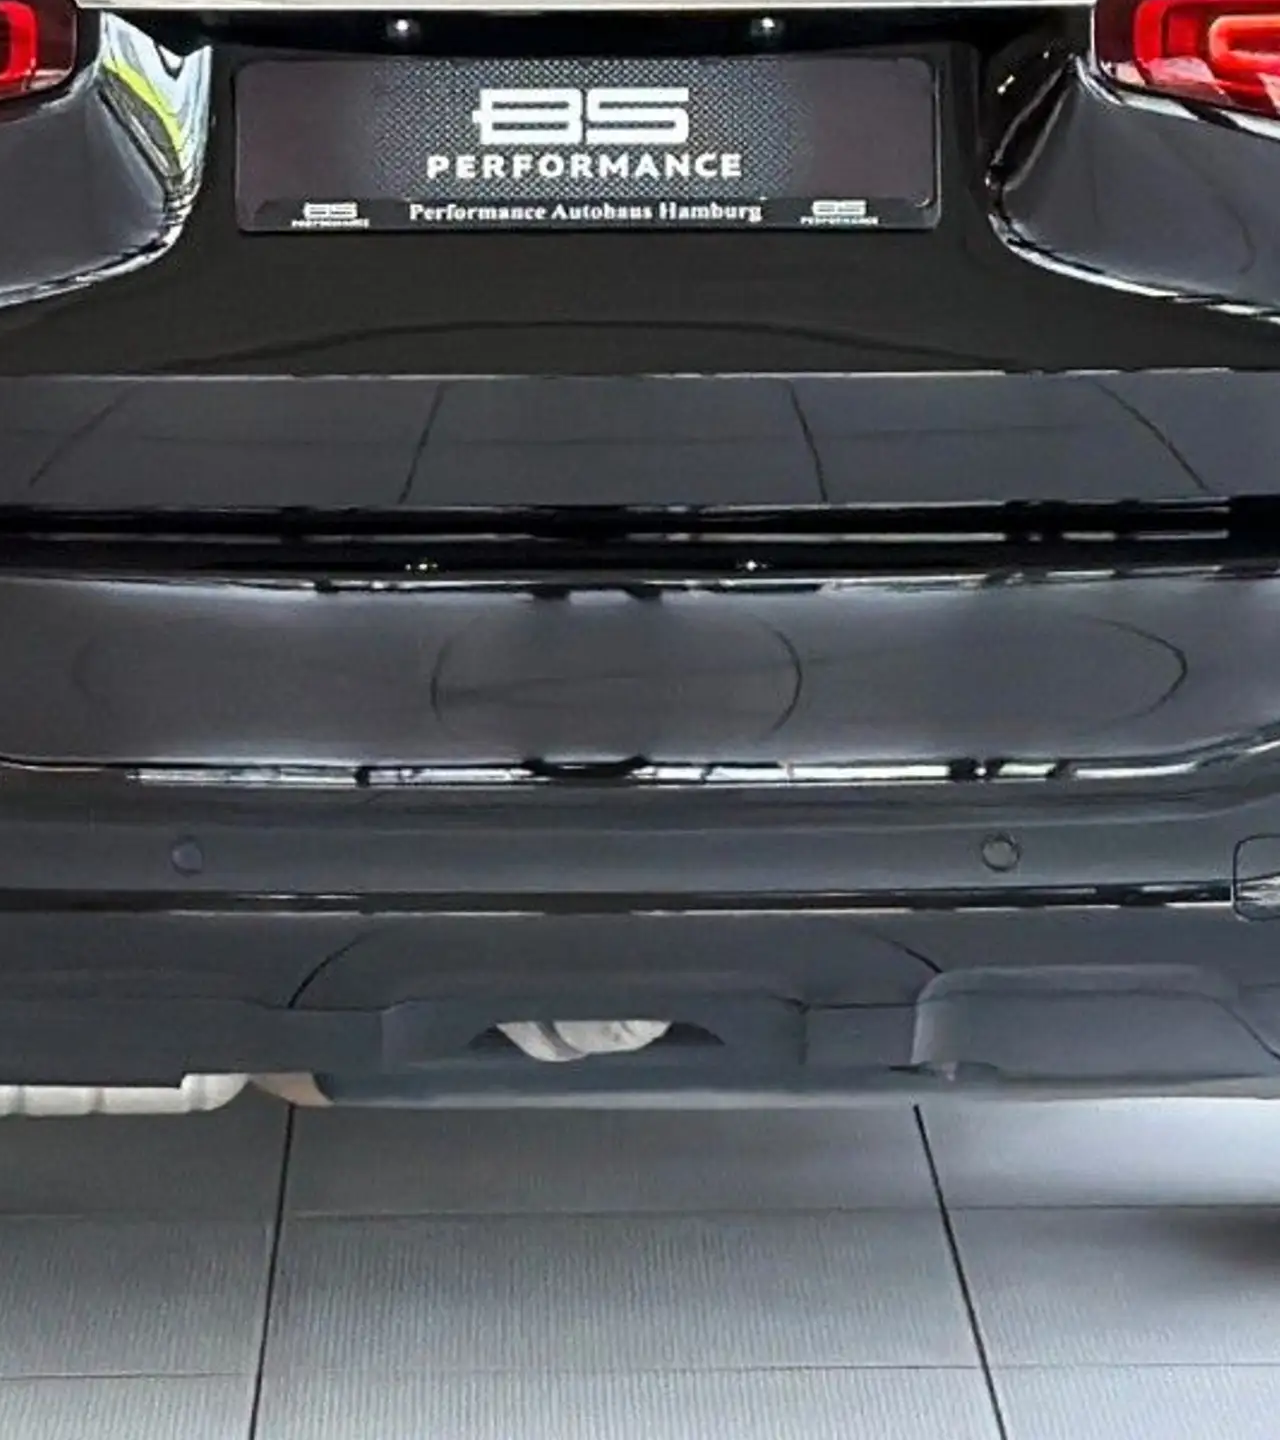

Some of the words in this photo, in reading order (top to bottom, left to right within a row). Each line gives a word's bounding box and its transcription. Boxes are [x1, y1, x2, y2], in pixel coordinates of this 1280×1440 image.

[426, 153, 742, 179] PERFORMANCE
[409, 202, 546, 221] Performance
[551, 203, 653, 220] Autohaus
[659, 202, 762, 222] Hamburg
